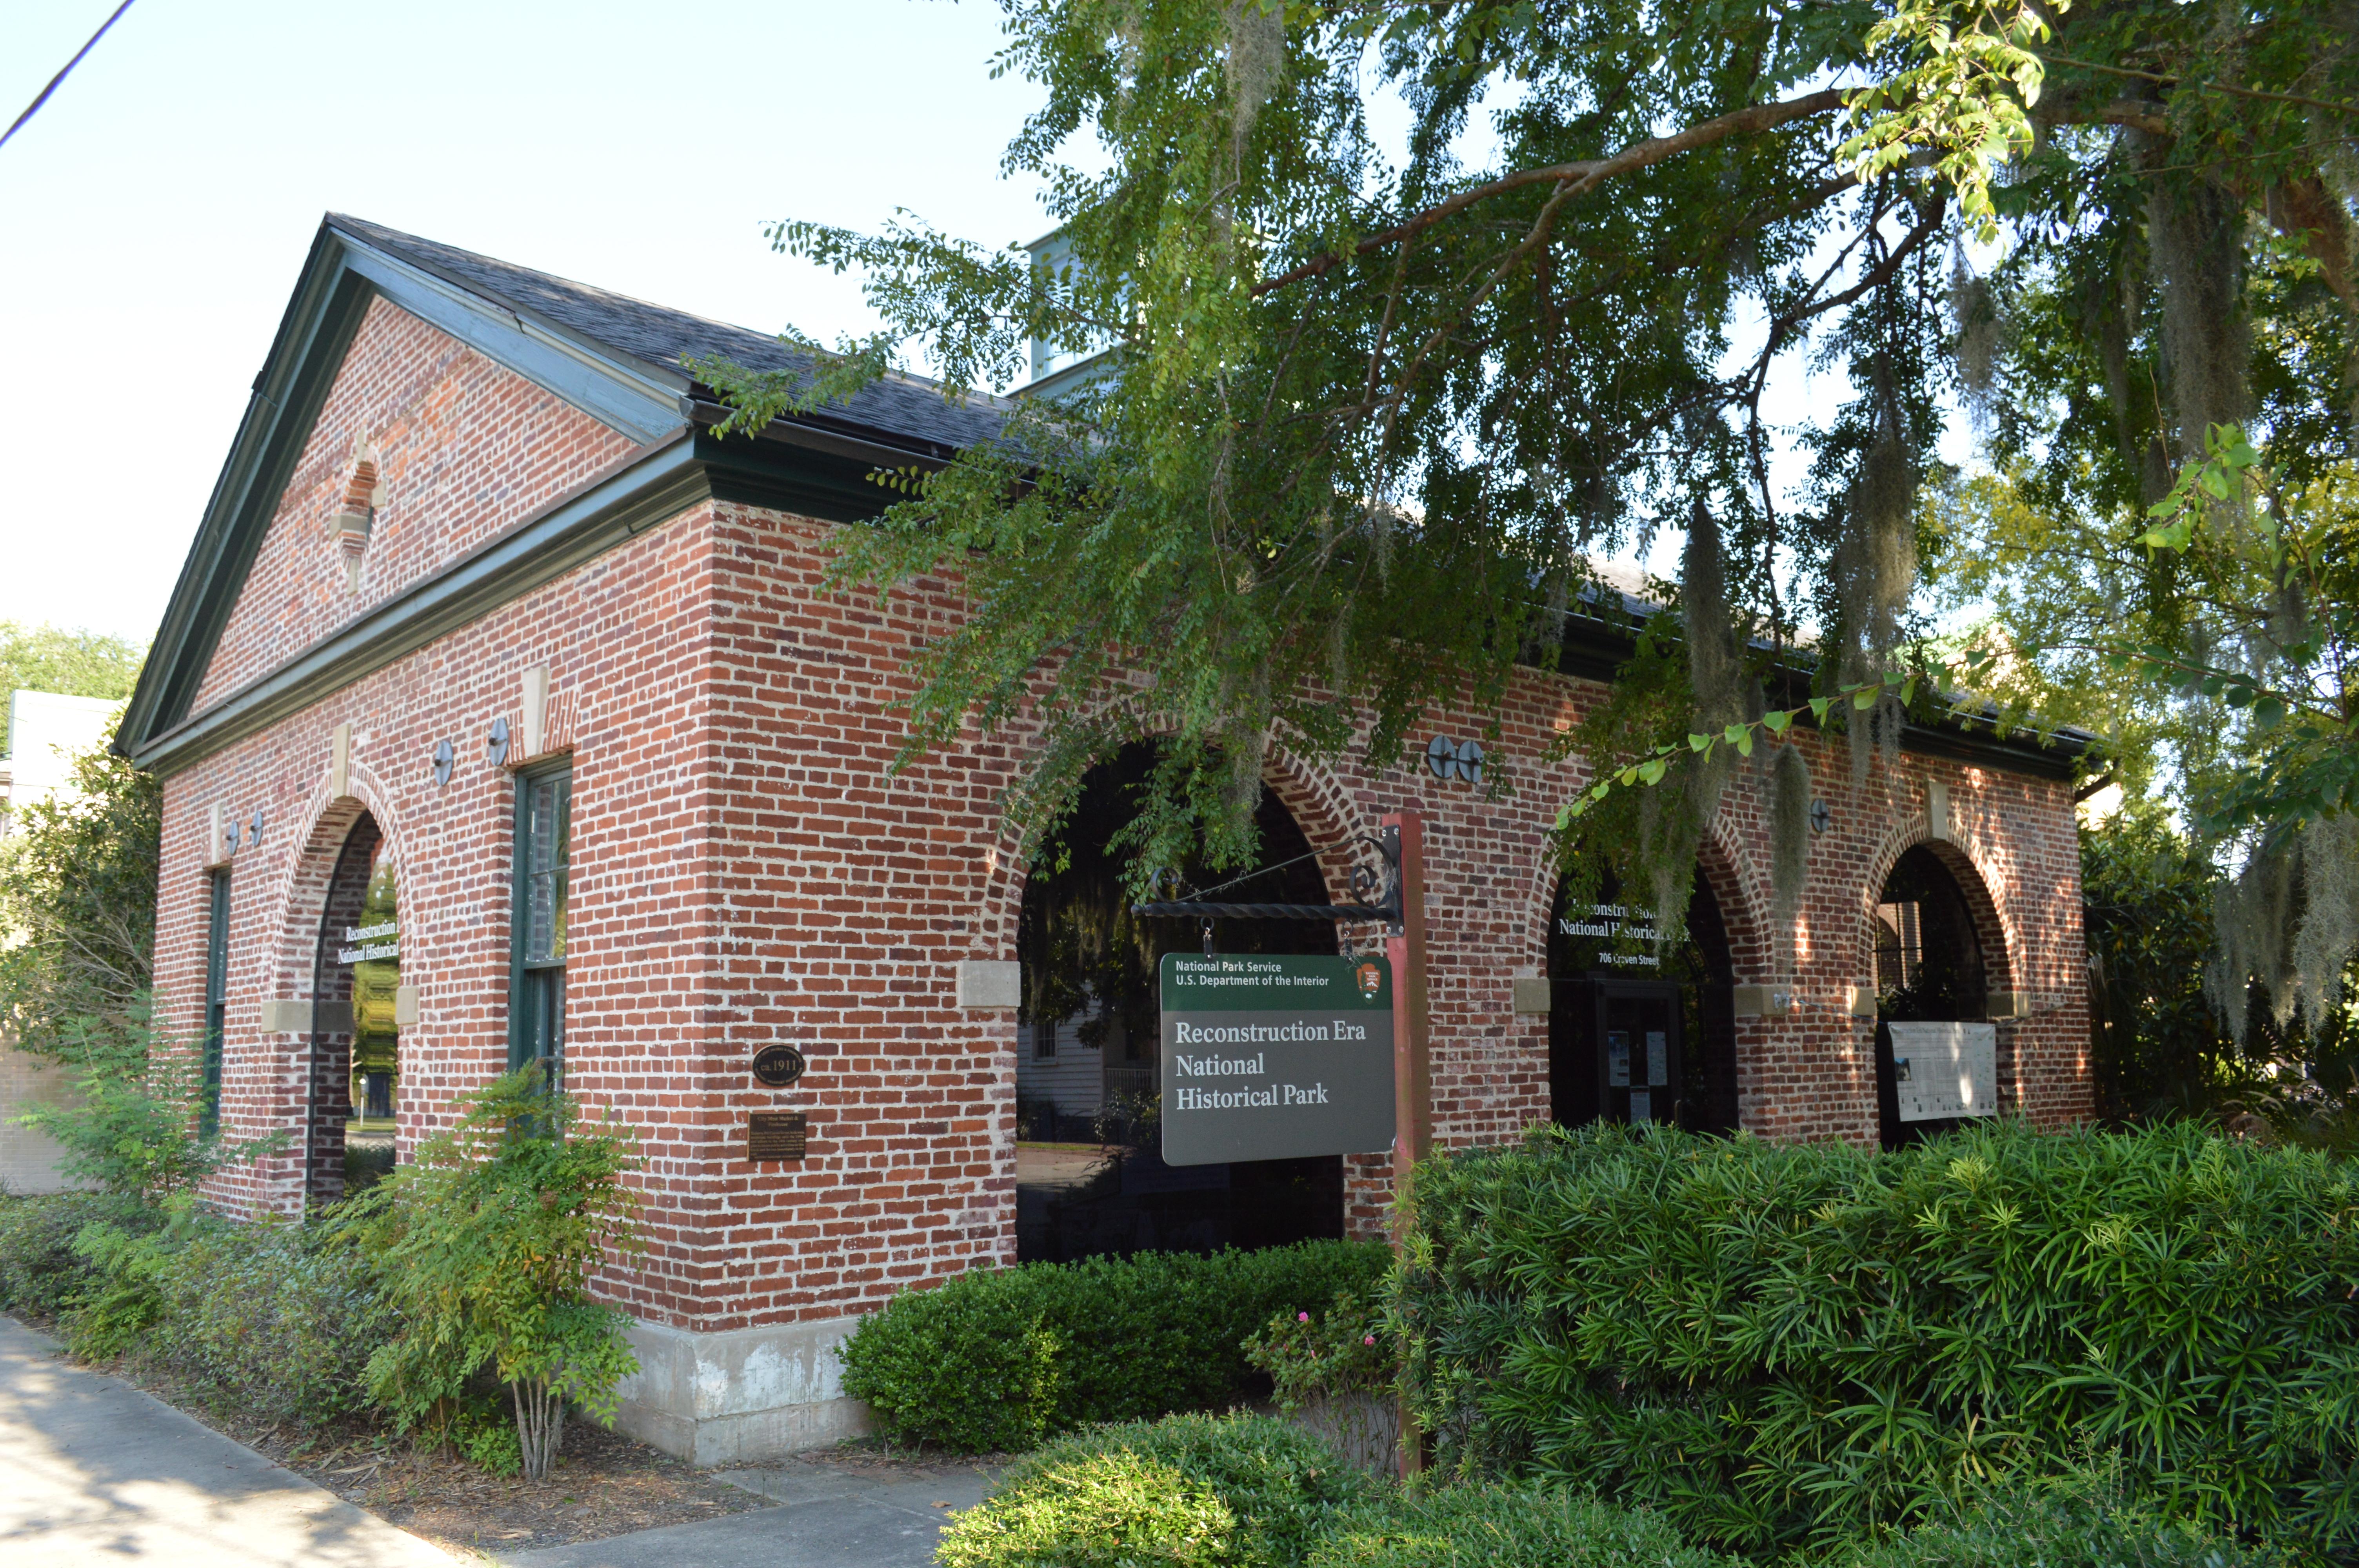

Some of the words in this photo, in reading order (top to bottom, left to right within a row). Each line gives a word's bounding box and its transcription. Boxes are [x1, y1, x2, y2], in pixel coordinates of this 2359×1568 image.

[346, 919, 395, 942] Reconstruction
[1559, 919, 1609, 936] National
[338, 945, 365, 964] National
[366, 939, 399, 960] Historical
[1599, 953, 1612, 963] 706
[1639, 955, 1659, 965] Street
[1176, 961, 1219, 971] National
[1222, 961, 1244, 972] Park
[1247, 962, 1281, 972] Service
[1176, 975, 1196, 985] U.S.
[1200, 975, 1259, 987] Department
[1262, 975, 1272, 985] of
[1275, 975, 1291, 985] the
[1294, 976, 1329, 986] Interior
[1176, 1021, 1329, 1043] Reconstruction
[1333, 1020, 1366, 1040] Era
[773, 1060, 796, 1071] 1911
[1176, 1053, 1264, 1076] National
[1176, 1084, 1278, 1110] Historical
[1283, 1083, 1329, 1105] Park
